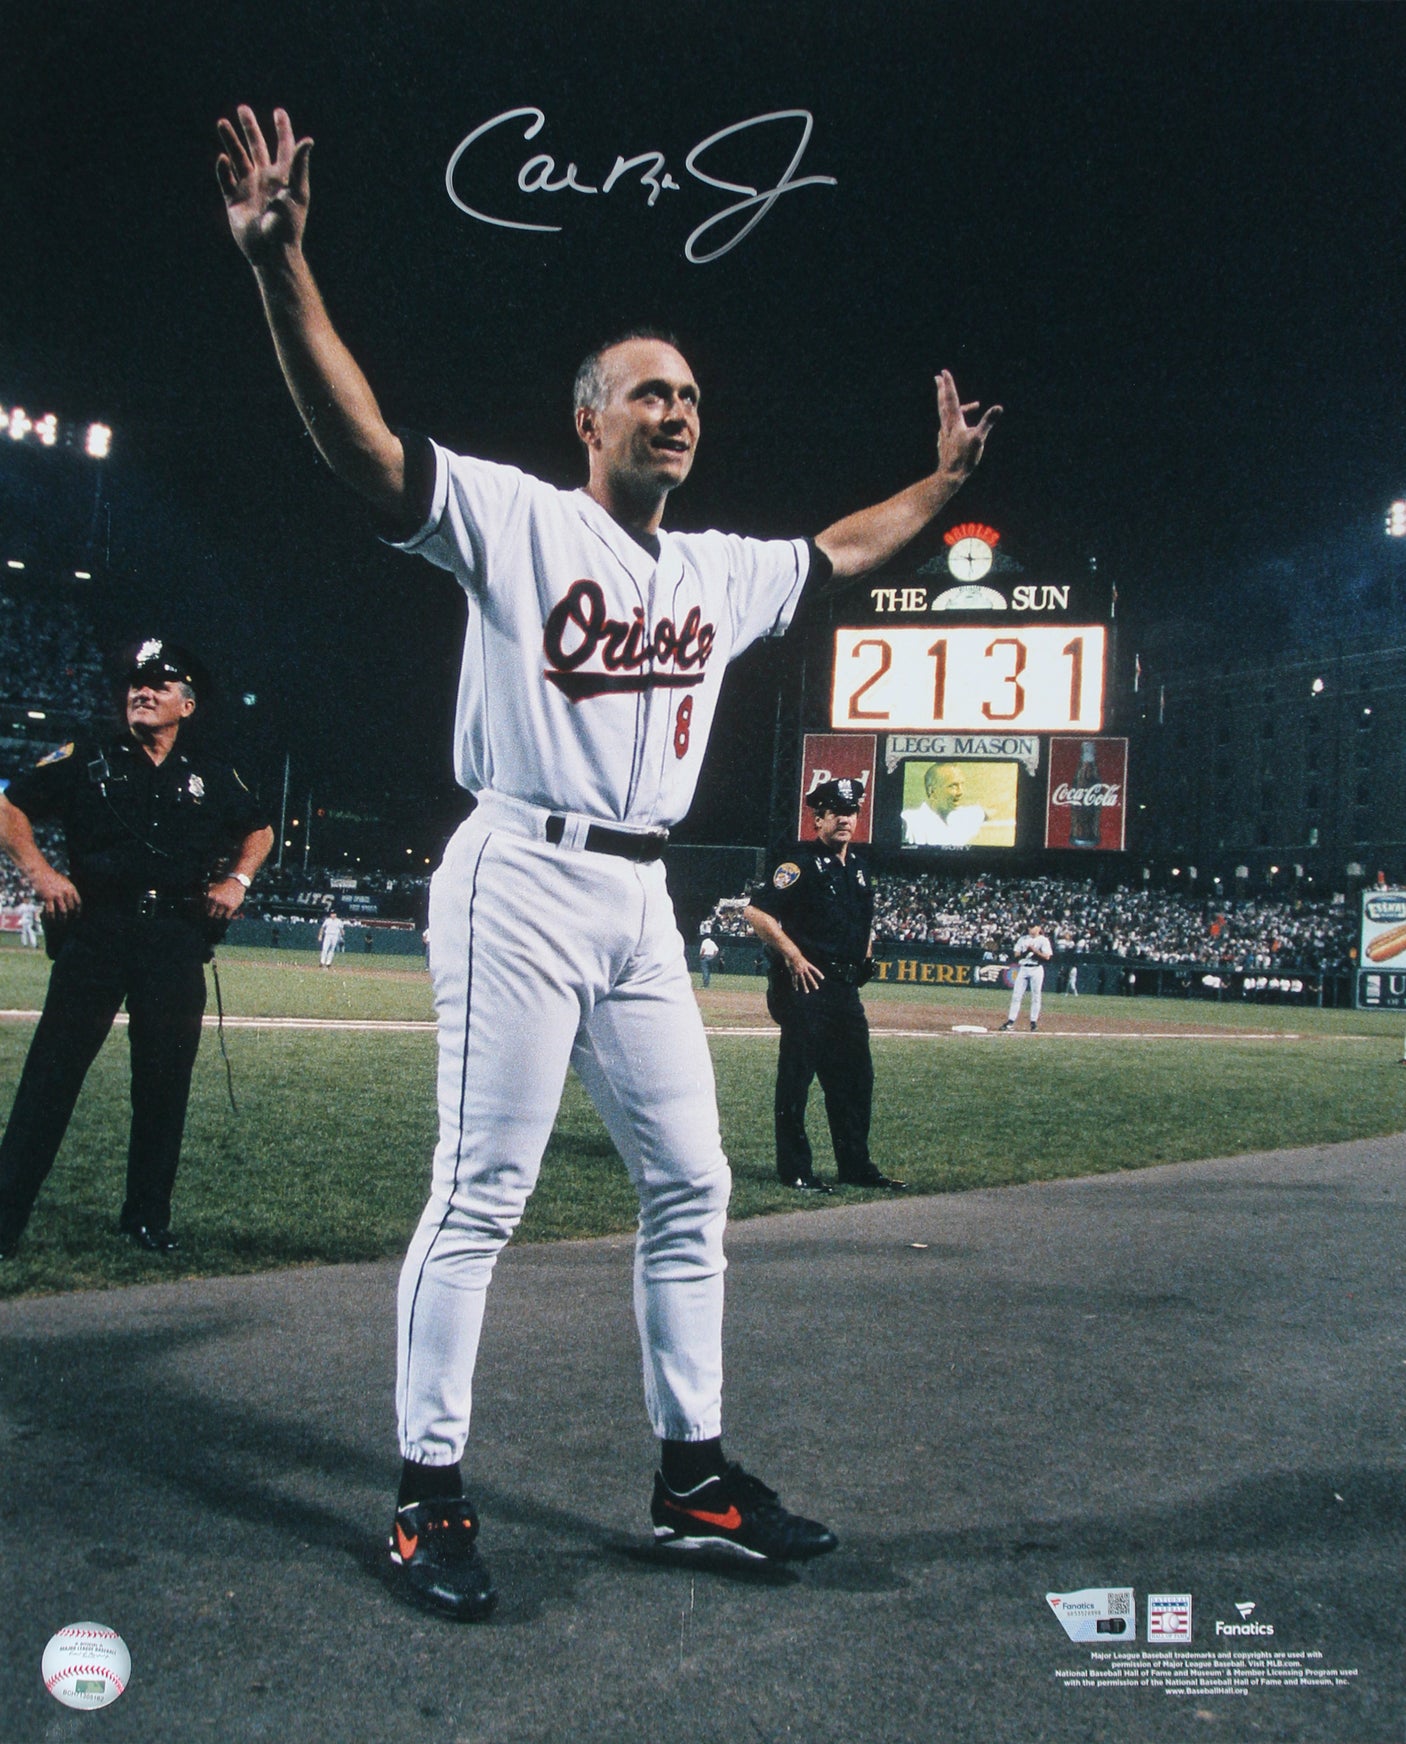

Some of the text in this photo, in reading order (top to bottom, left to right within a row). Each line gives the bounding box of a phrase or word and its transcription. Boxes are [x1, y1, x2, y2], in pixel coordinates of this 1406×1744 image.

[943, 521, 1001, 549] ORIOLES
[870, 586, 1070, 612] THE SUN
[543, 578, 719, 671] Oriole
[847, 636, 1084, 722] 2131
[673, 694, 693, 760] 8
[890, 737, 1033, 755] LEGG MASON
[1052, 782, 1120, 807] Coca-Cola
[896, 959, 971, 985] HERE
